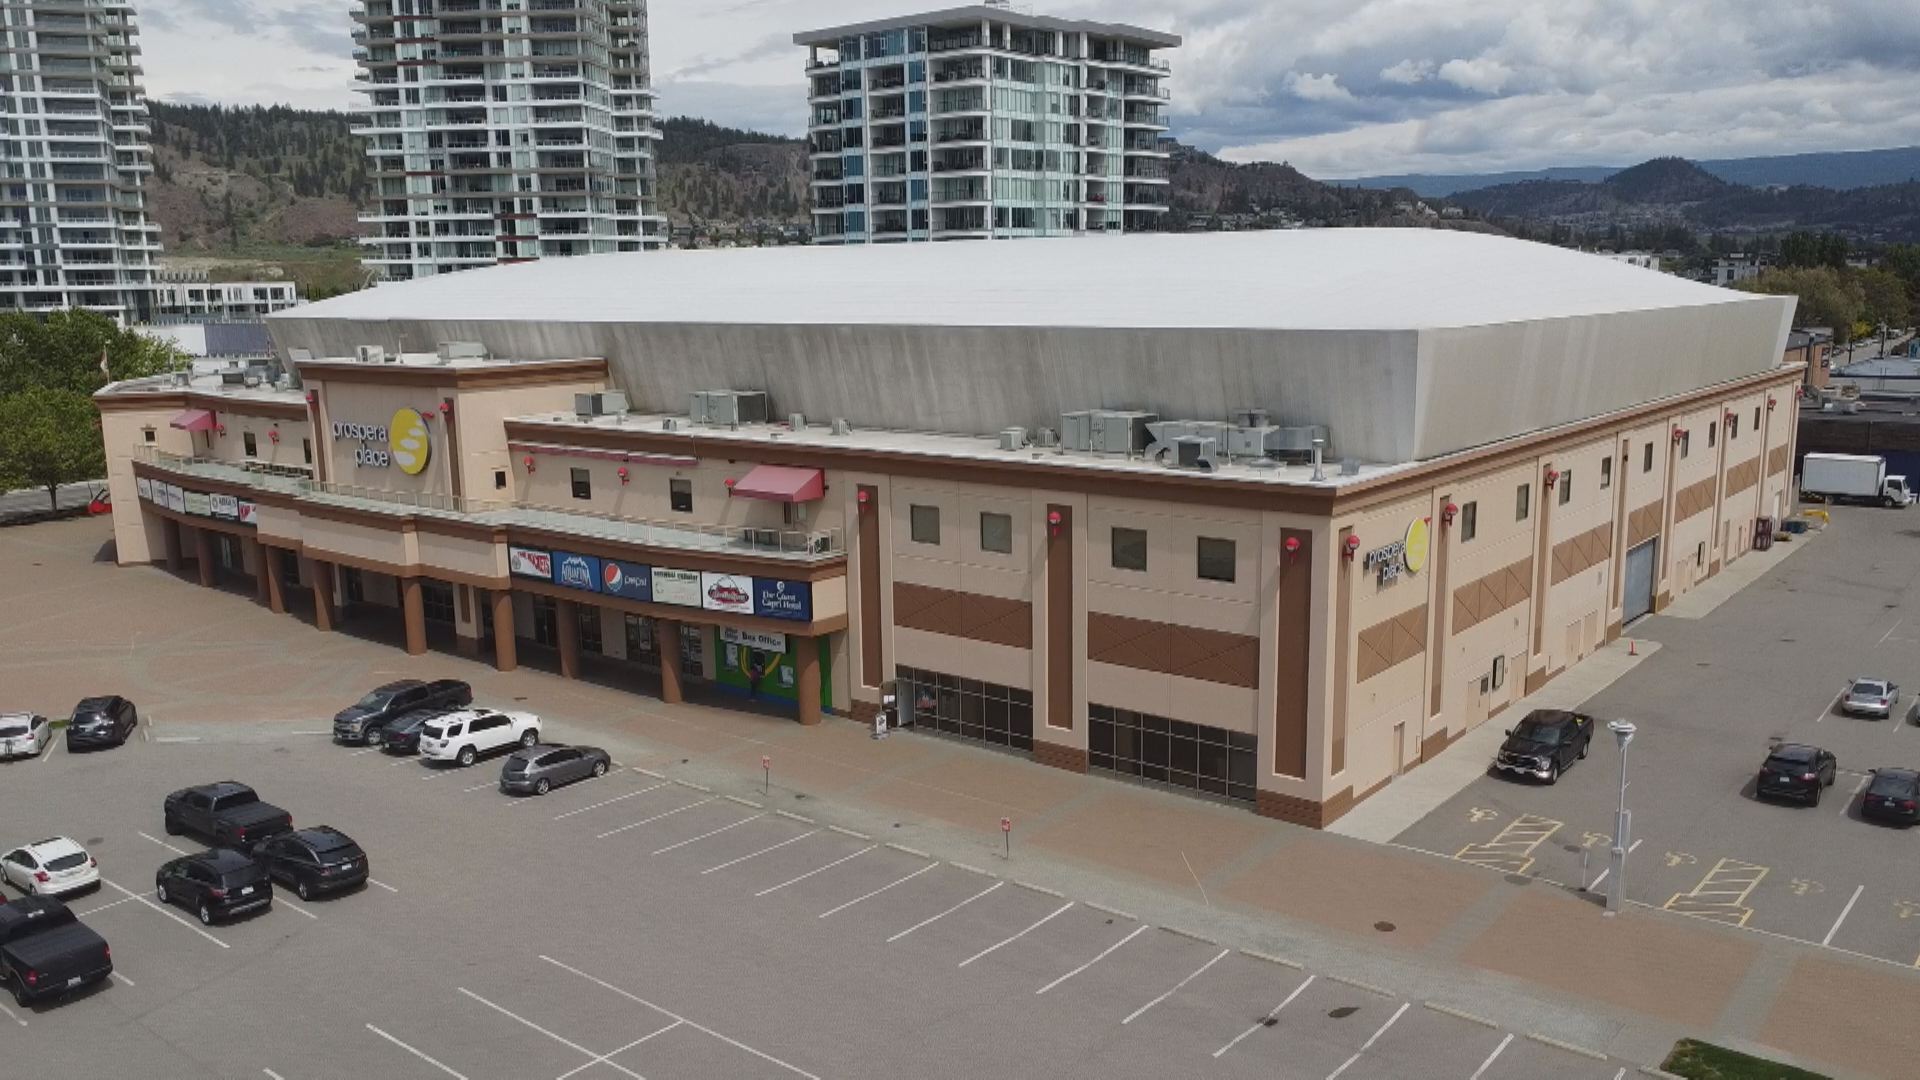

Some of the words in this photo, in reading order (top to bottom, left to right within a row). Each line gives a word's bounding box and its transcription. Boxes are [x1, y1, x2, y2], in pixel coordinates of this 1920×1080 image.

[333, 421, 388, 444] prospera
[355, 442, 389, 468] place
[1369, 541, 1405, 564] prospera
[624, 575, 647, 590] pepsi
[783, 601, 802, 610] Hotel
[742, 631, 756, 642] Box
[759, 635, 782, 646] Office
